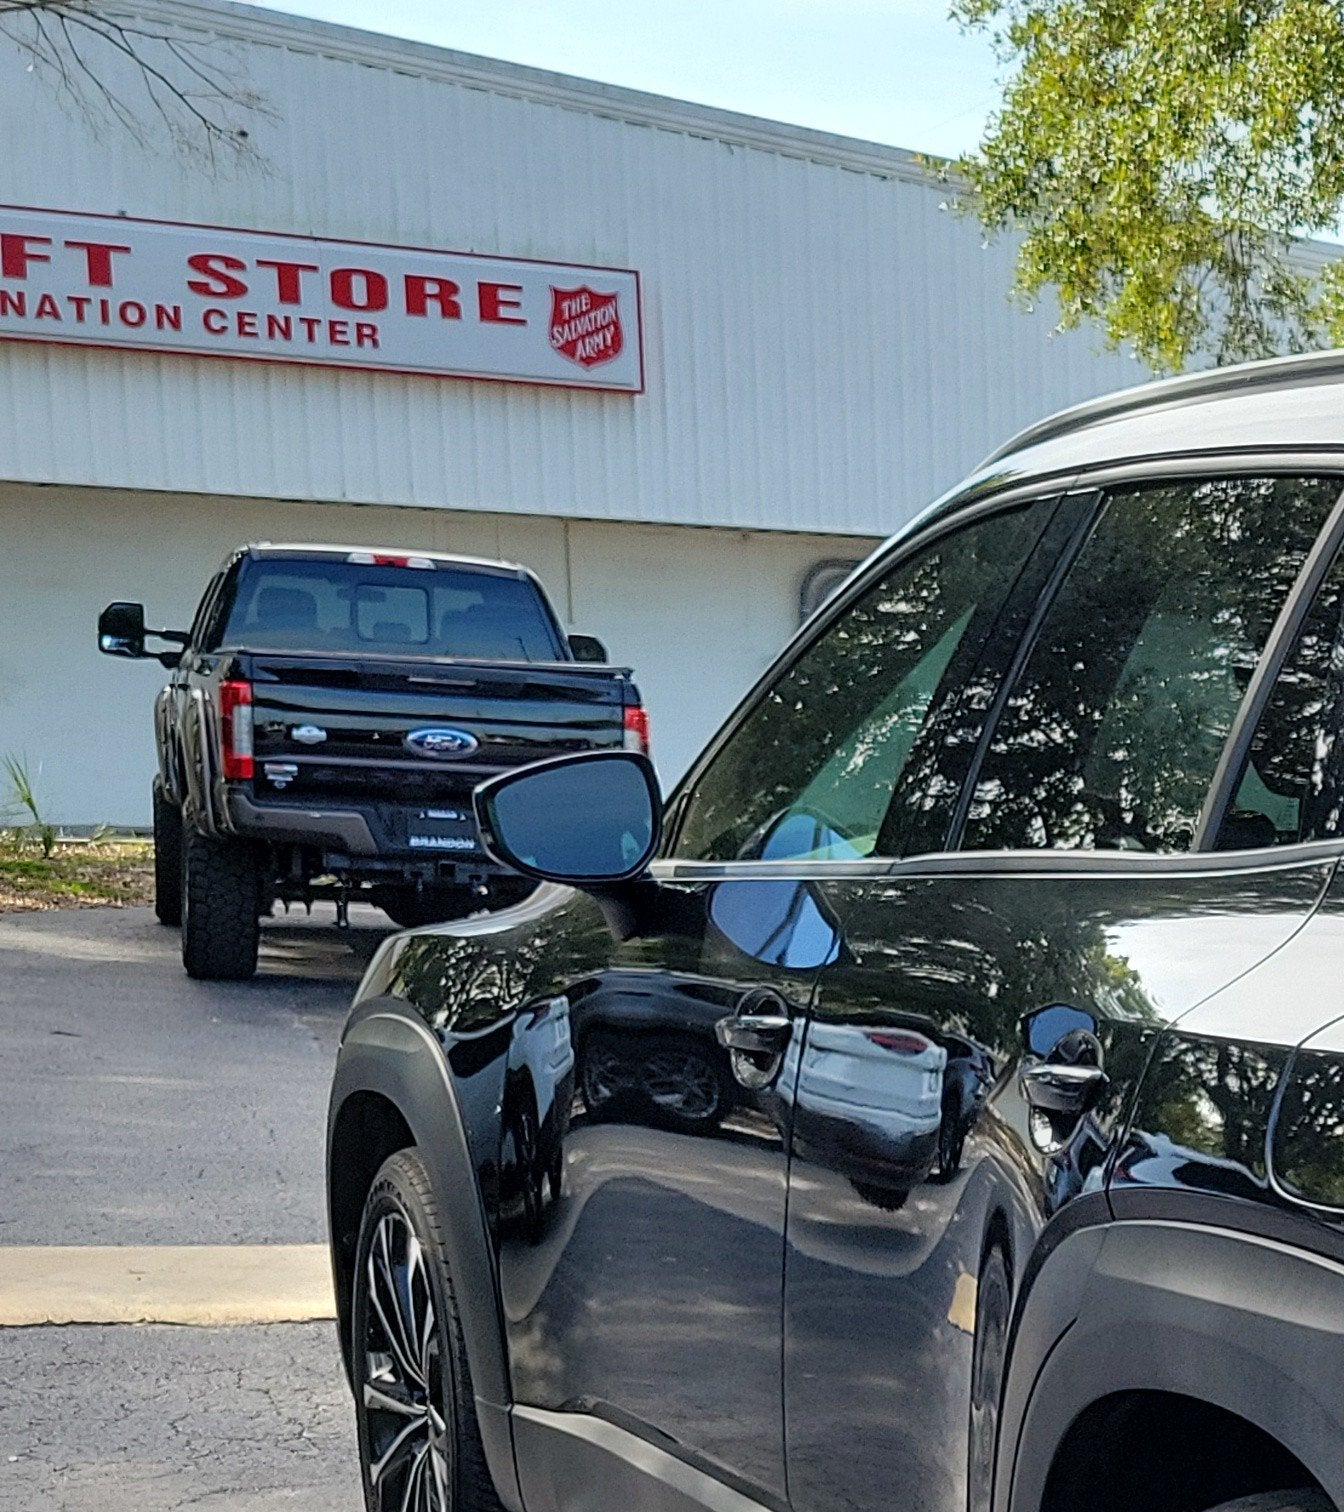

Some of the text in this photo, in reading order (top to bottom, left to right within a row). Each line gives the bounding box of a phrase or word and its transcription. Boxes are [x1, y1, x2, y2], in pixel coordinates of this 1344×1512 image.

[0, 233, 528, 326] FT STORE
[0, 289, 380, 349] NATION CENTER
[550, 300, 617, 348] SALVATION
[562, 293, 591, 321] THE
[575, 324, 615, 360] ARMY
